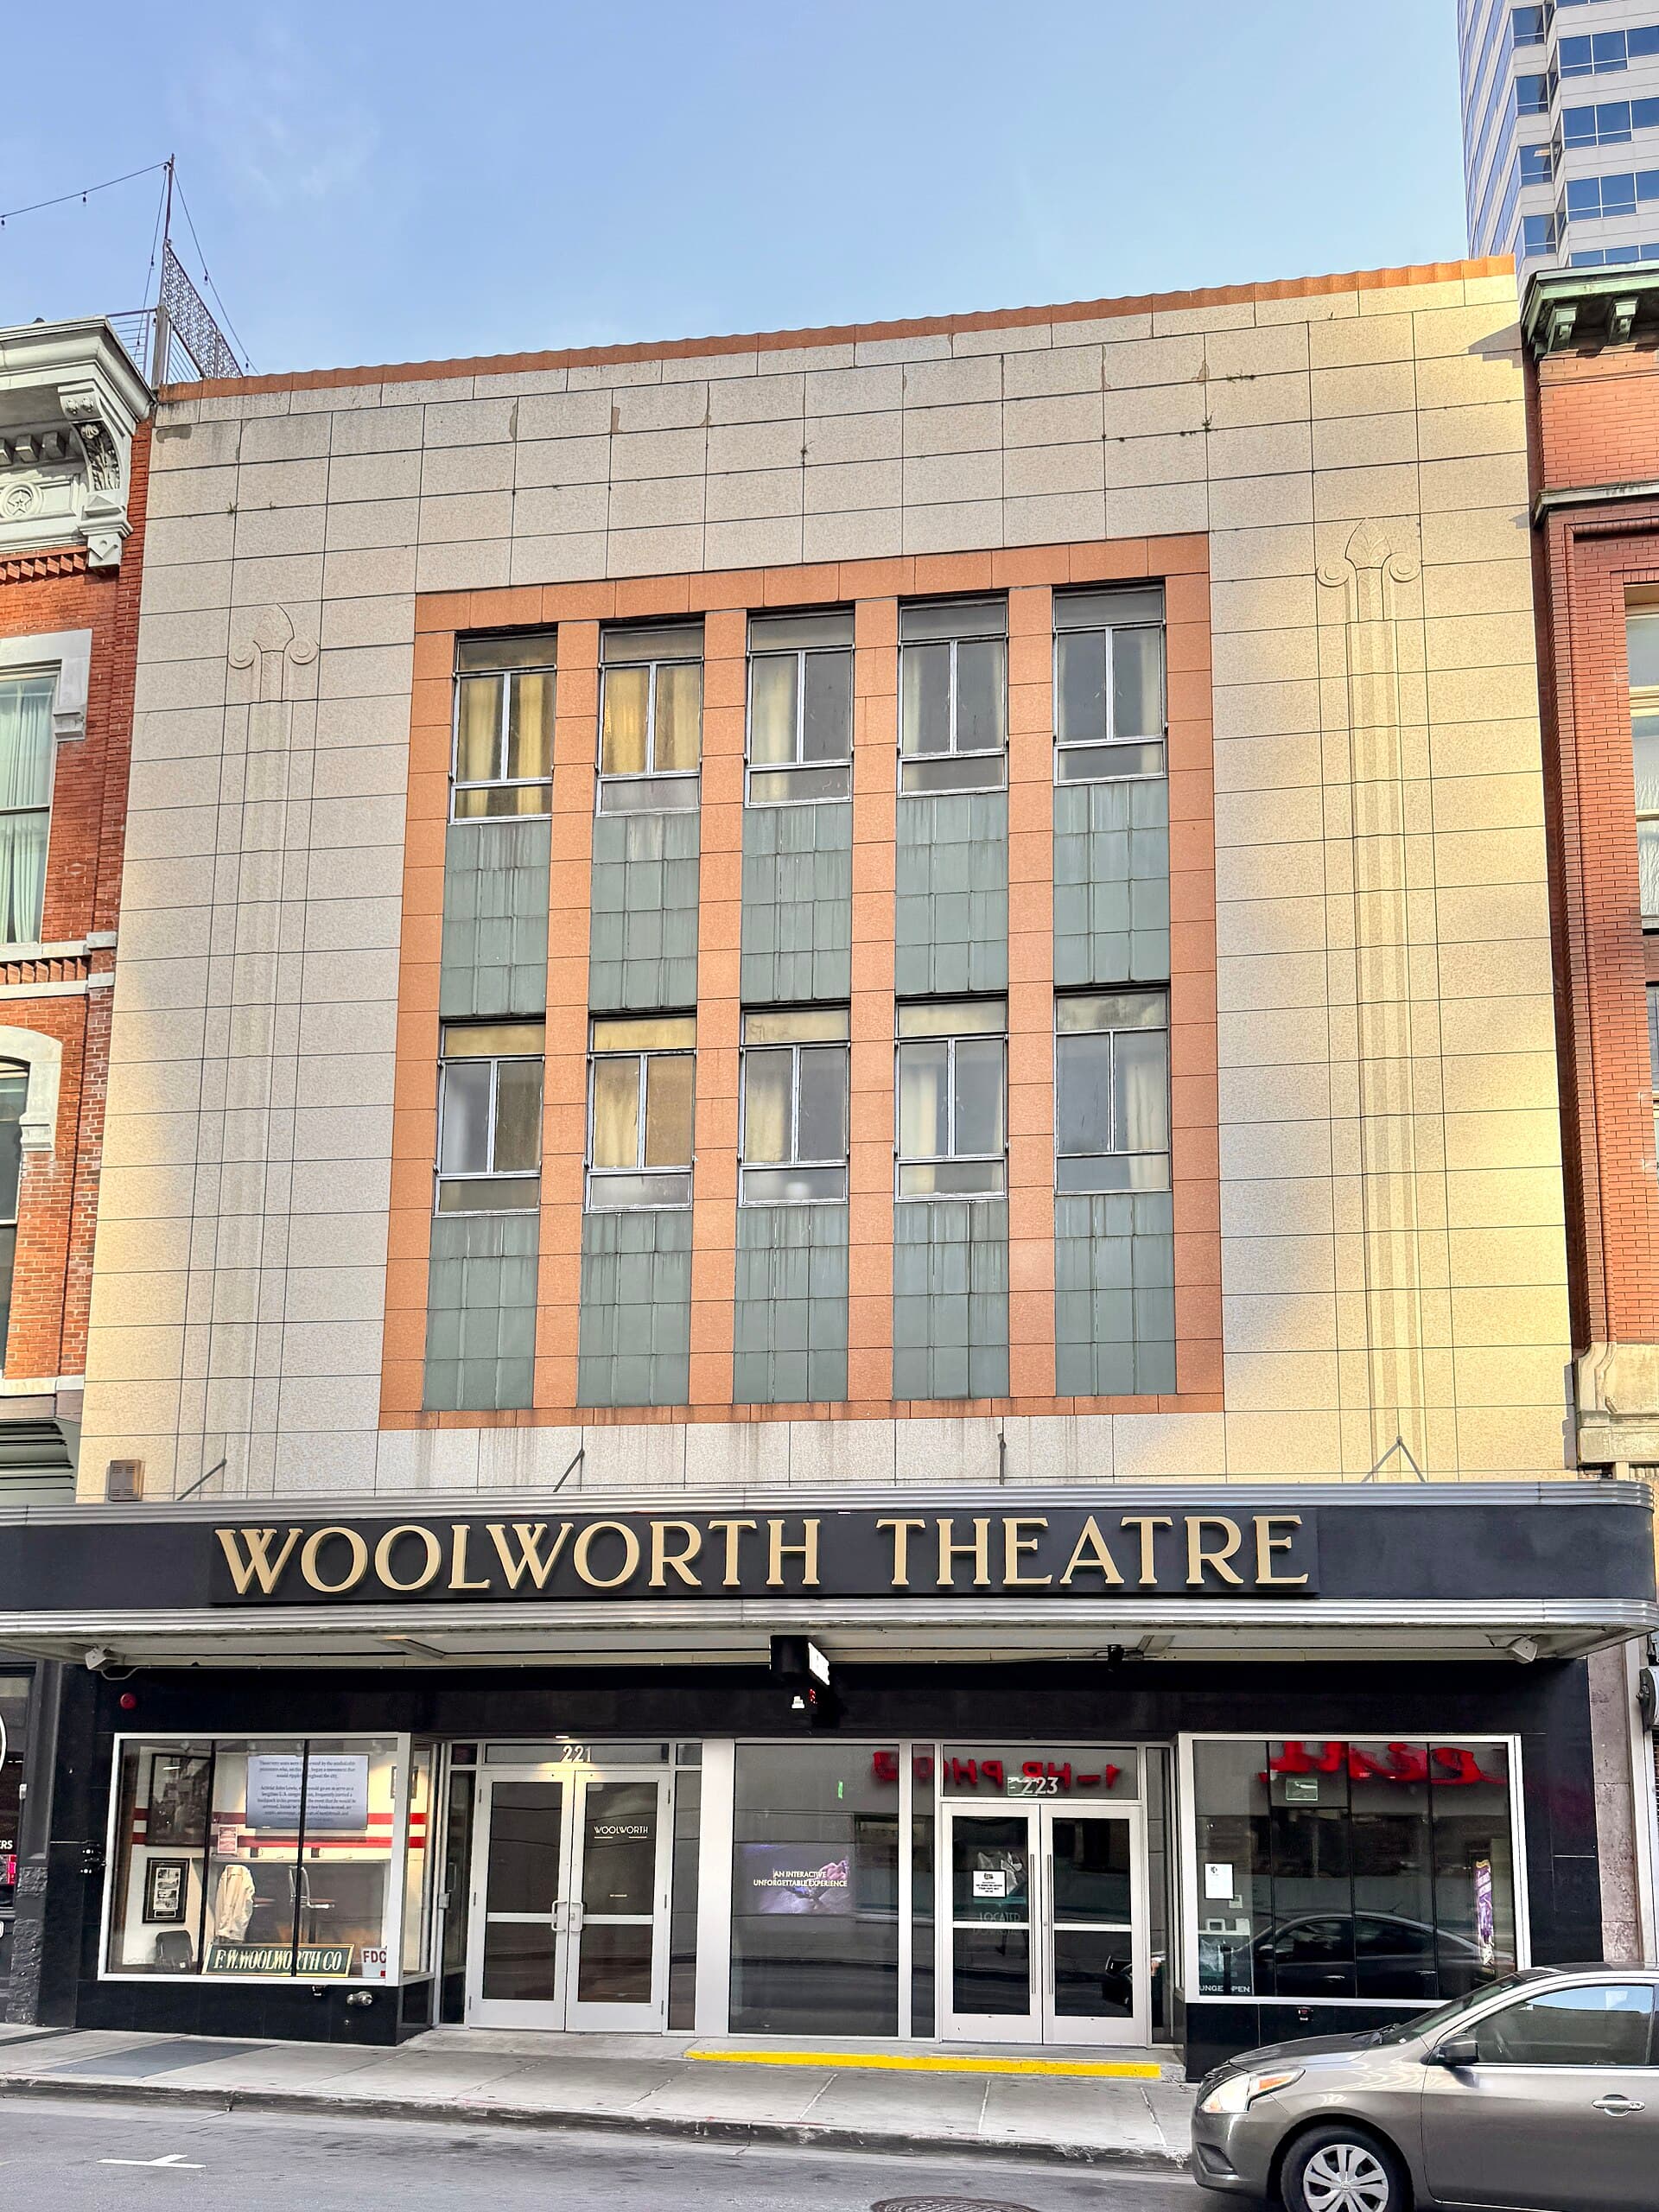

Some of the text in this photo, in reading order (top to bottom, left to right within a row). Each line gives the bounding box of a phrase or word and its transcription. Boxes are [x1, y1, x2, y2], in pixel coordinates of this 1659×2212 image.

[215, 1515, 1309, 1595] WOOLWORTH THEATRE
[561, 1745, 592, 1763] 221
[1021, 1777, 1058, 1795] 223
[594, 1826, 648, 1834] WOOLWORTH
[323, 1951, 342, 1970] CO
[363, 1950, 386, 1963] FDC
